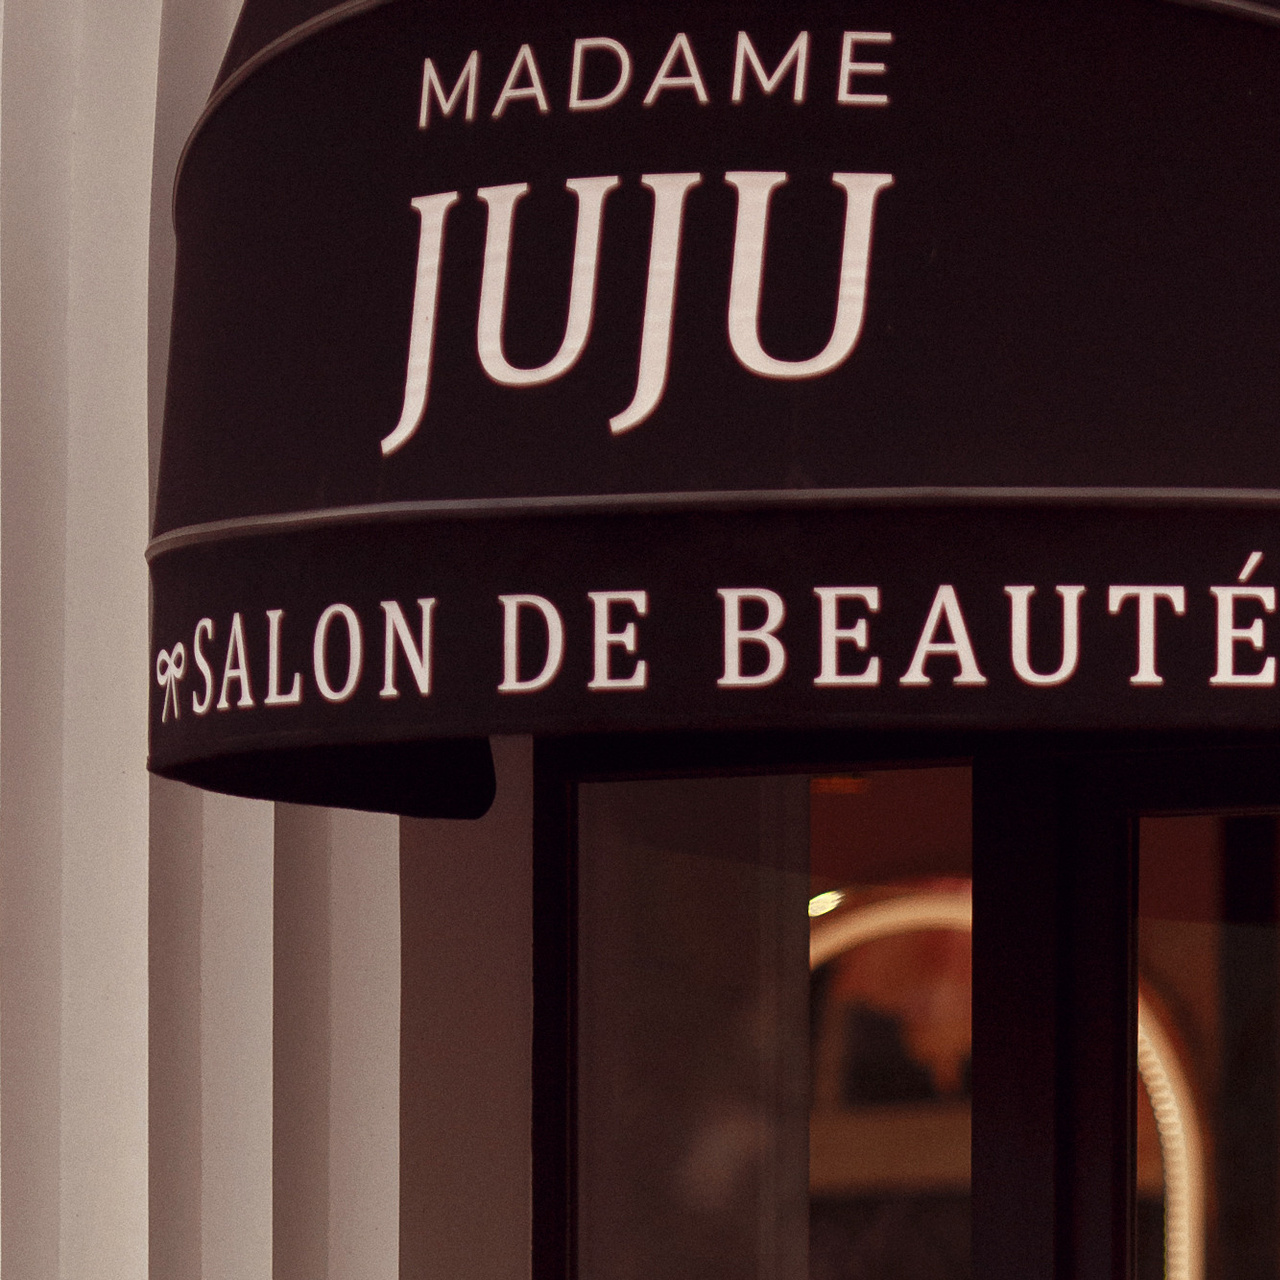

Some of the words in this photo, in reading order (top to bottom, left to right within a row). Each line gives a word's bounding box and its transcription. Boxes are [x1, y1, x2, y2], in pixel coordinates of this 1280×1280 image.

[417, 29, 894, 128] MADAME
[380, 171, 894, 455] JUJU
[191, 598, 437, 714] SALON
[498, 588, 650, 691] DE
[717, 551, 1277, 686] BEAUTÉ
